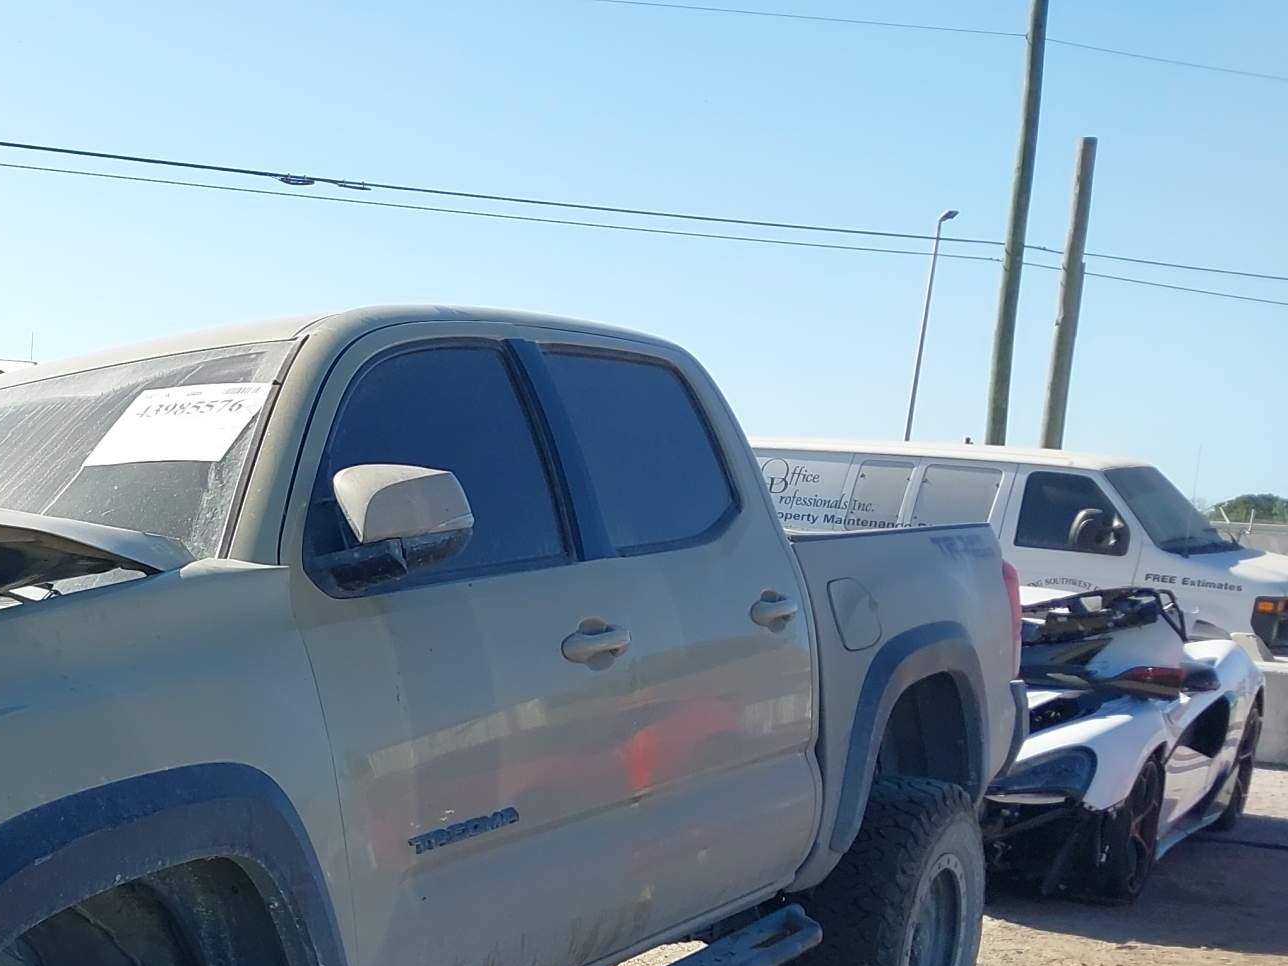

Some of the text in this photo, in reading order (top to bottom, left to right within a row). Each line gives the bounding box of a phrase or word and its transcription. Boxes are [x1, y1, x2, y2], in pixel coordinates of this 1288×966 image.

[136, 398, 247, 419] 43985576
[761, 457, 820, 487] Office
[768, 476, 875, 513] Professionals Inc.
[776, 511, 818, 524] operty
[1045, 577, 1094, 590] SOUTHWEST
[1144, 573, 1243, 592] FREE Estimates
